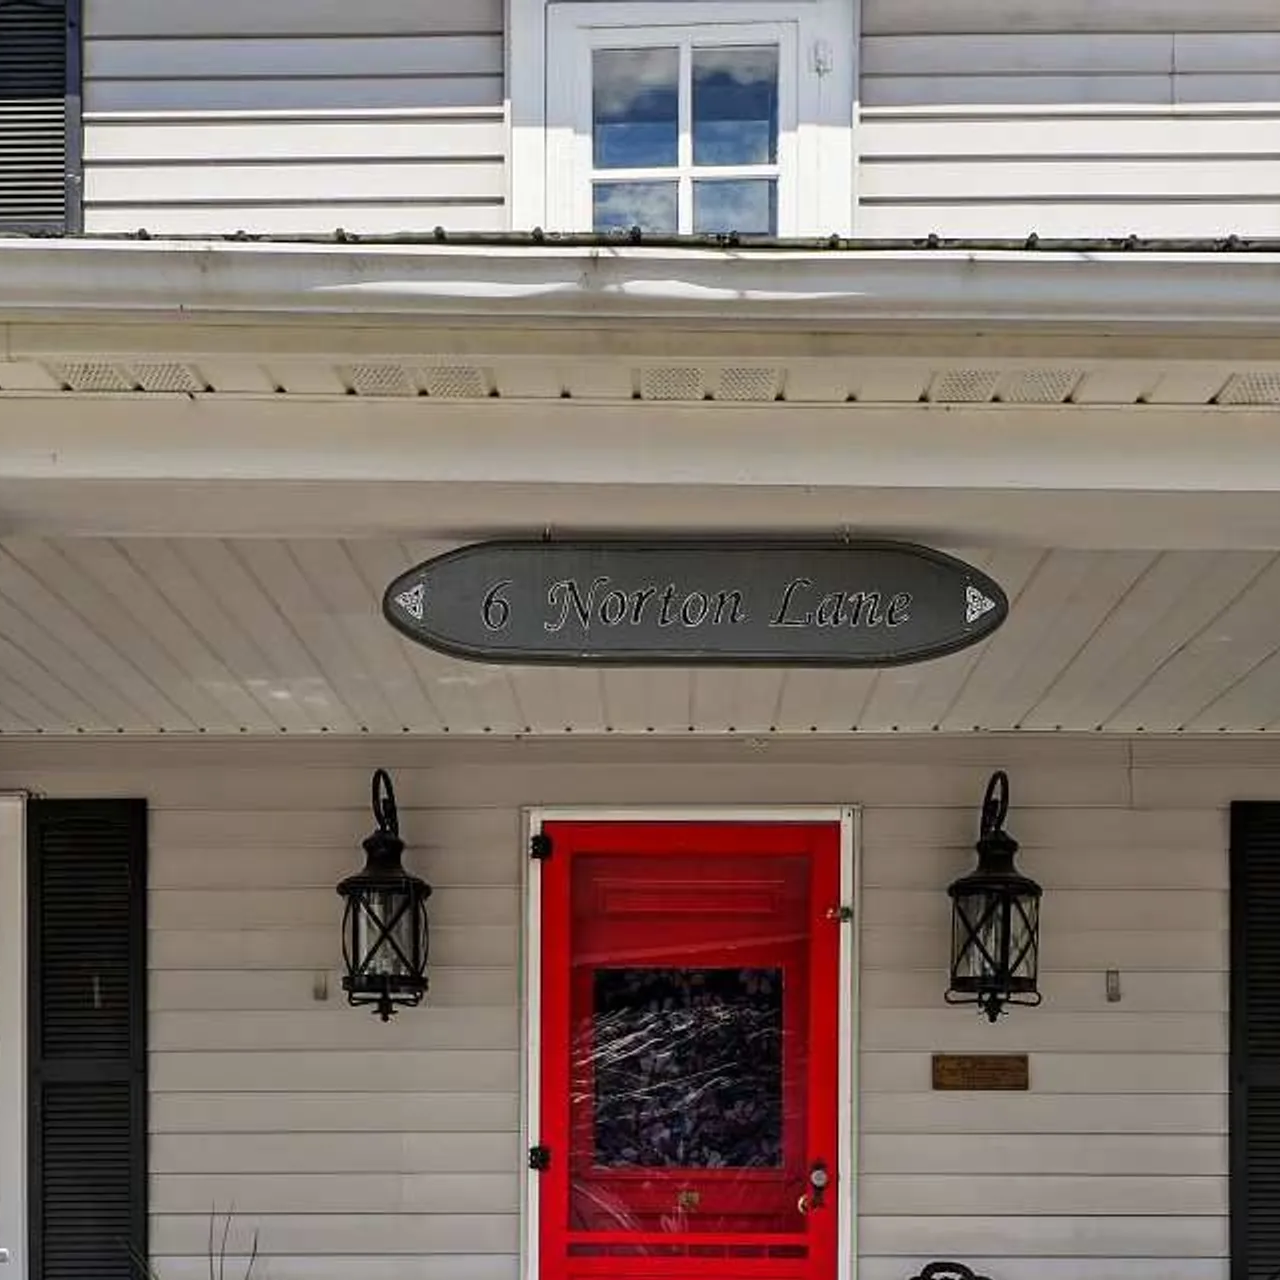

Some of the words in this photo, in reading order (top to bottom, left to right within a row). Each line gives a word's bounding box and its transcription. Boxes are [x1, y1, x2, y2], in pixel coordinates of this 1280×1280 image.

[481, 578, 513, 631] 6
[543, 575, 745, 631] Norton
[768, 577, 913, 629] Lane
